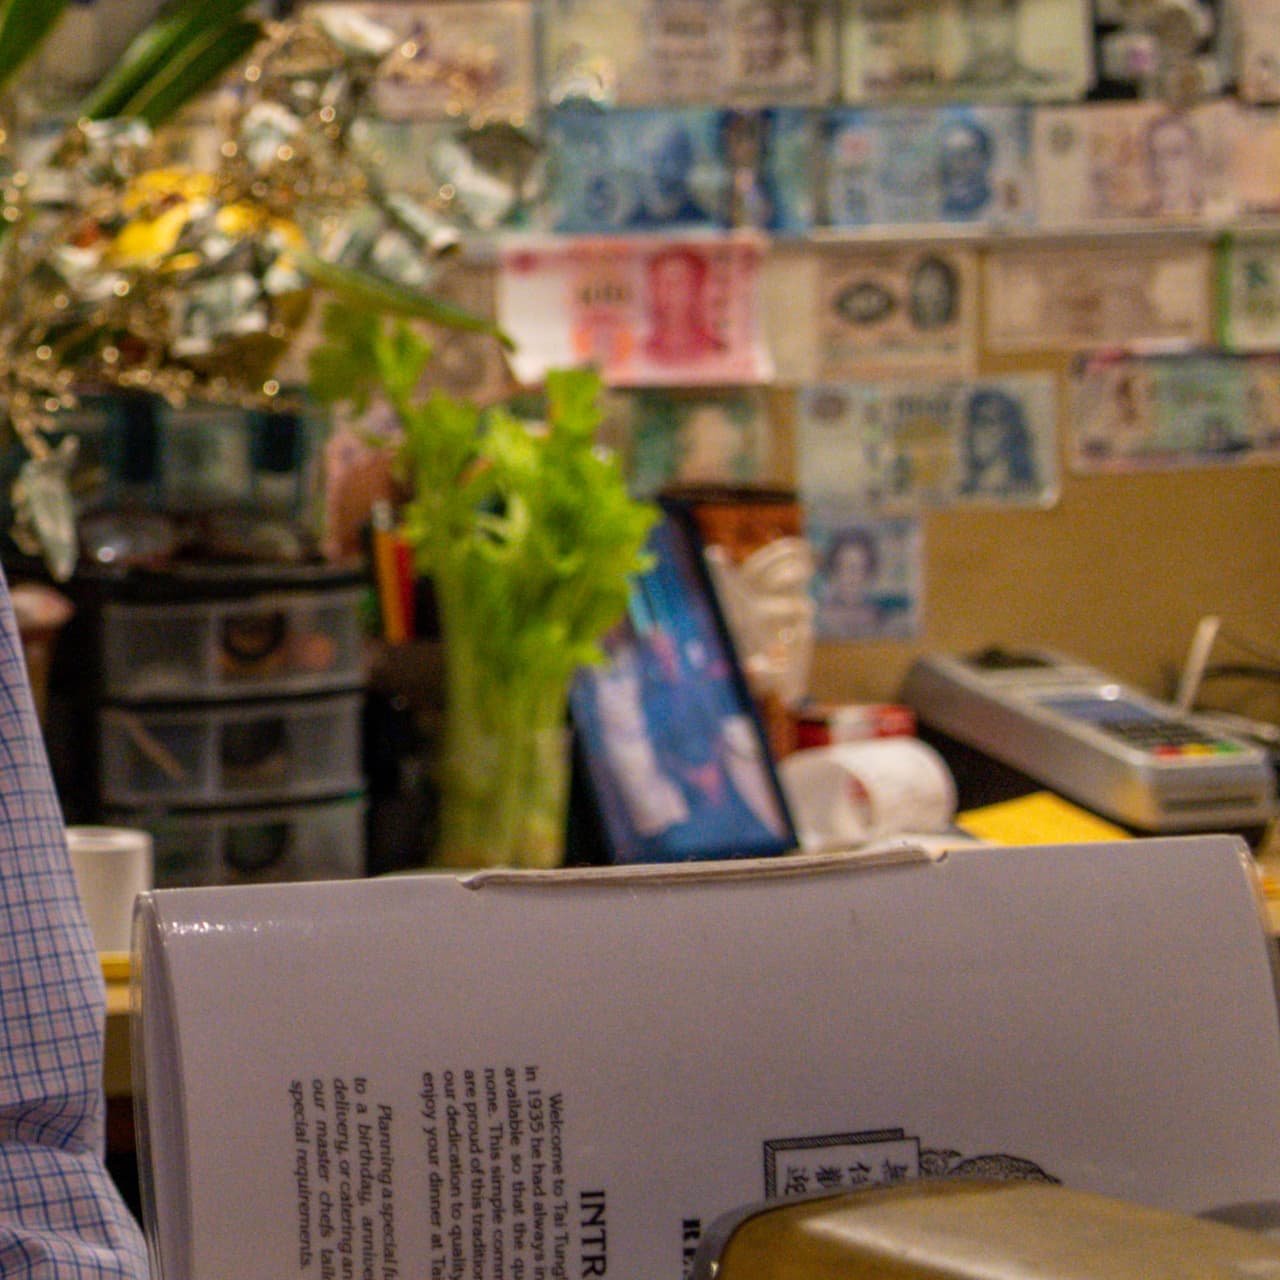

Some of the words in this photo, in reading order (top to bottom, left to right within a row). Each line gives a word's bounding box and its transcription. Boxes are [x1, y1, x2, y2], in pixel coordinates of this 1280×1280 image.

[354, 1077, 367, 1094] to
[443, 1070, 456, 1099] our
[464, 1070, 477, 1097] are
[525, 1065, 539, 1081] in
[288, 1079, 309, 1143] special
[312, 1079, 326, 1111] our
[356, 1103, 368, 1114] a
[421, 1072, 437, 1120] enjoy
[484, 1068, 498, 1117] none.
[505, 1067, 524, 1146] available
[528, 1090, 544, 1133] 1935
[376, 1104, 394, 1185] Planning
[423, 1127, 439, 1165] your
[463, 1102, 482, 1154] proud
[489, 1122, 504, 1160] This
[549, 1092, 565, 1174] Welcome
[316, 1120, 331, 1183] master
[446, 1104, 464, 1198] dedication
[470, 1157, 484, 1174] of
[511, 1154, 523, 1174] so
[531, 1138, 544, 1159] he
[339, 1159, 351, 1177] or
[532, 1164, 547, 1196] had
[381, 1187, 393, 1199] a
[428, 1172, 443, 1226] dinner
[471, 1178, 485, 1209] this
[489, 1166, 505, 1224] simple
[512, 1181, 525, 1215] that
[553, 1180, 566, 1196] to
[294, 1148, 313, 1270] requirements.
[318, 1191, 334, 1238] chefs
[337, 1181, 354, 1253] catering
[451, 1202, 465, 1219] to
[554, 1201, 568, 1227] Tai
[380, 1202, 398, 1264] special
[431, 1234, 443, 1250] at
[513, 1223, 527, 1249] the
[531, 1202, 547, 1261] always
[580, 1190, 607, 1280] INTR
